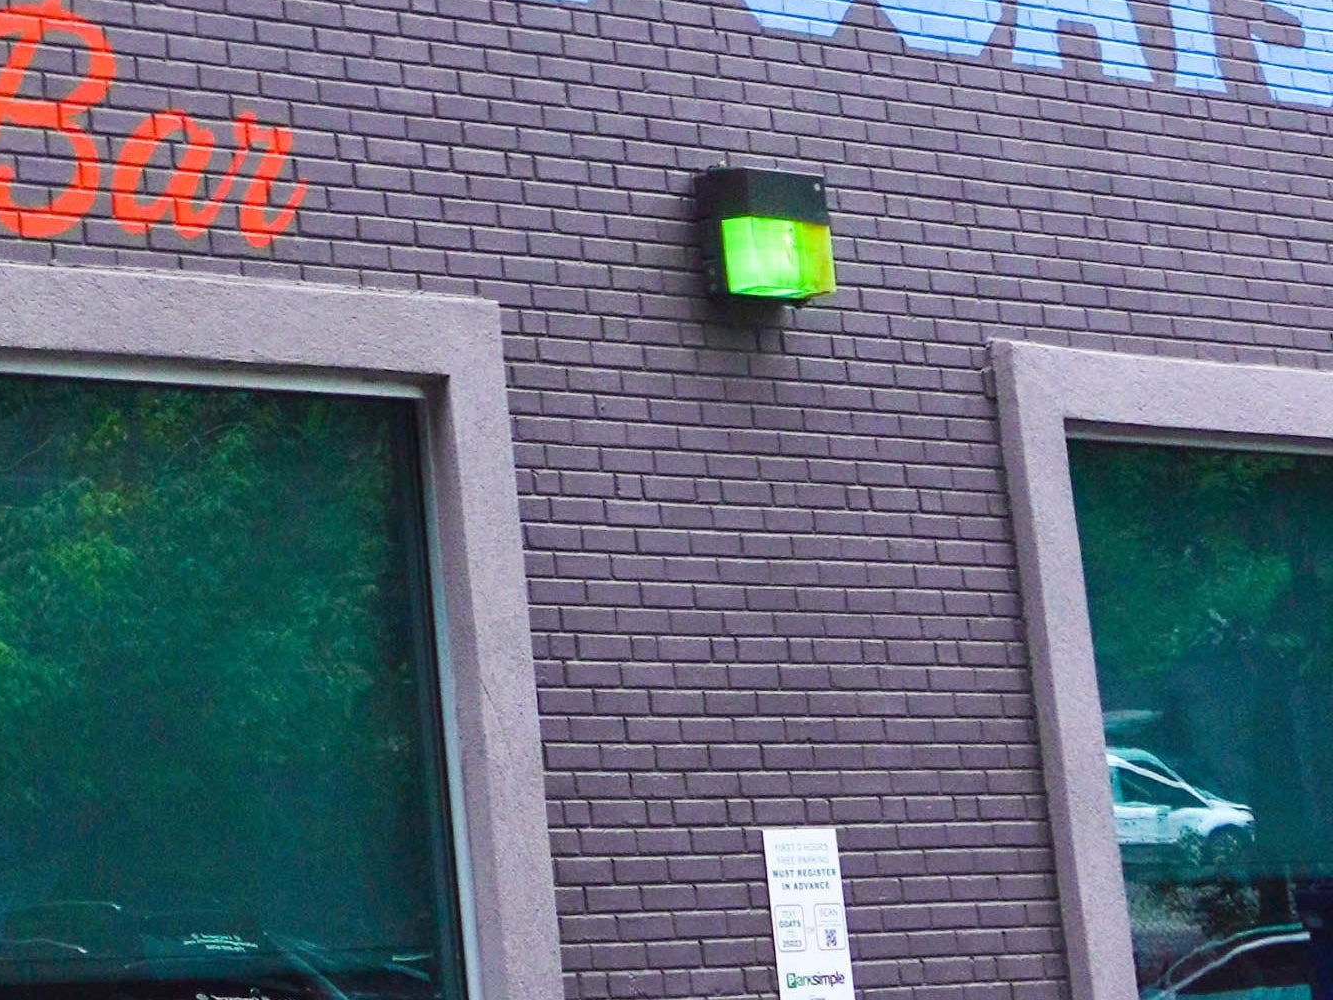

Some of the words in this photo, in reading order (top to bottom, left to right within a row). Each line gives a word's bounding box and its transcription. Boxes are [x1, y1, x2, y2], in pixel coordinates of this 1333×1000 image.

[773, 869, 794, 878] MUST
[797, 868, 836, 877] REGISTER
[781, 882, 791, 891] IN
[793, 881, 830, 890] ADVANCE
